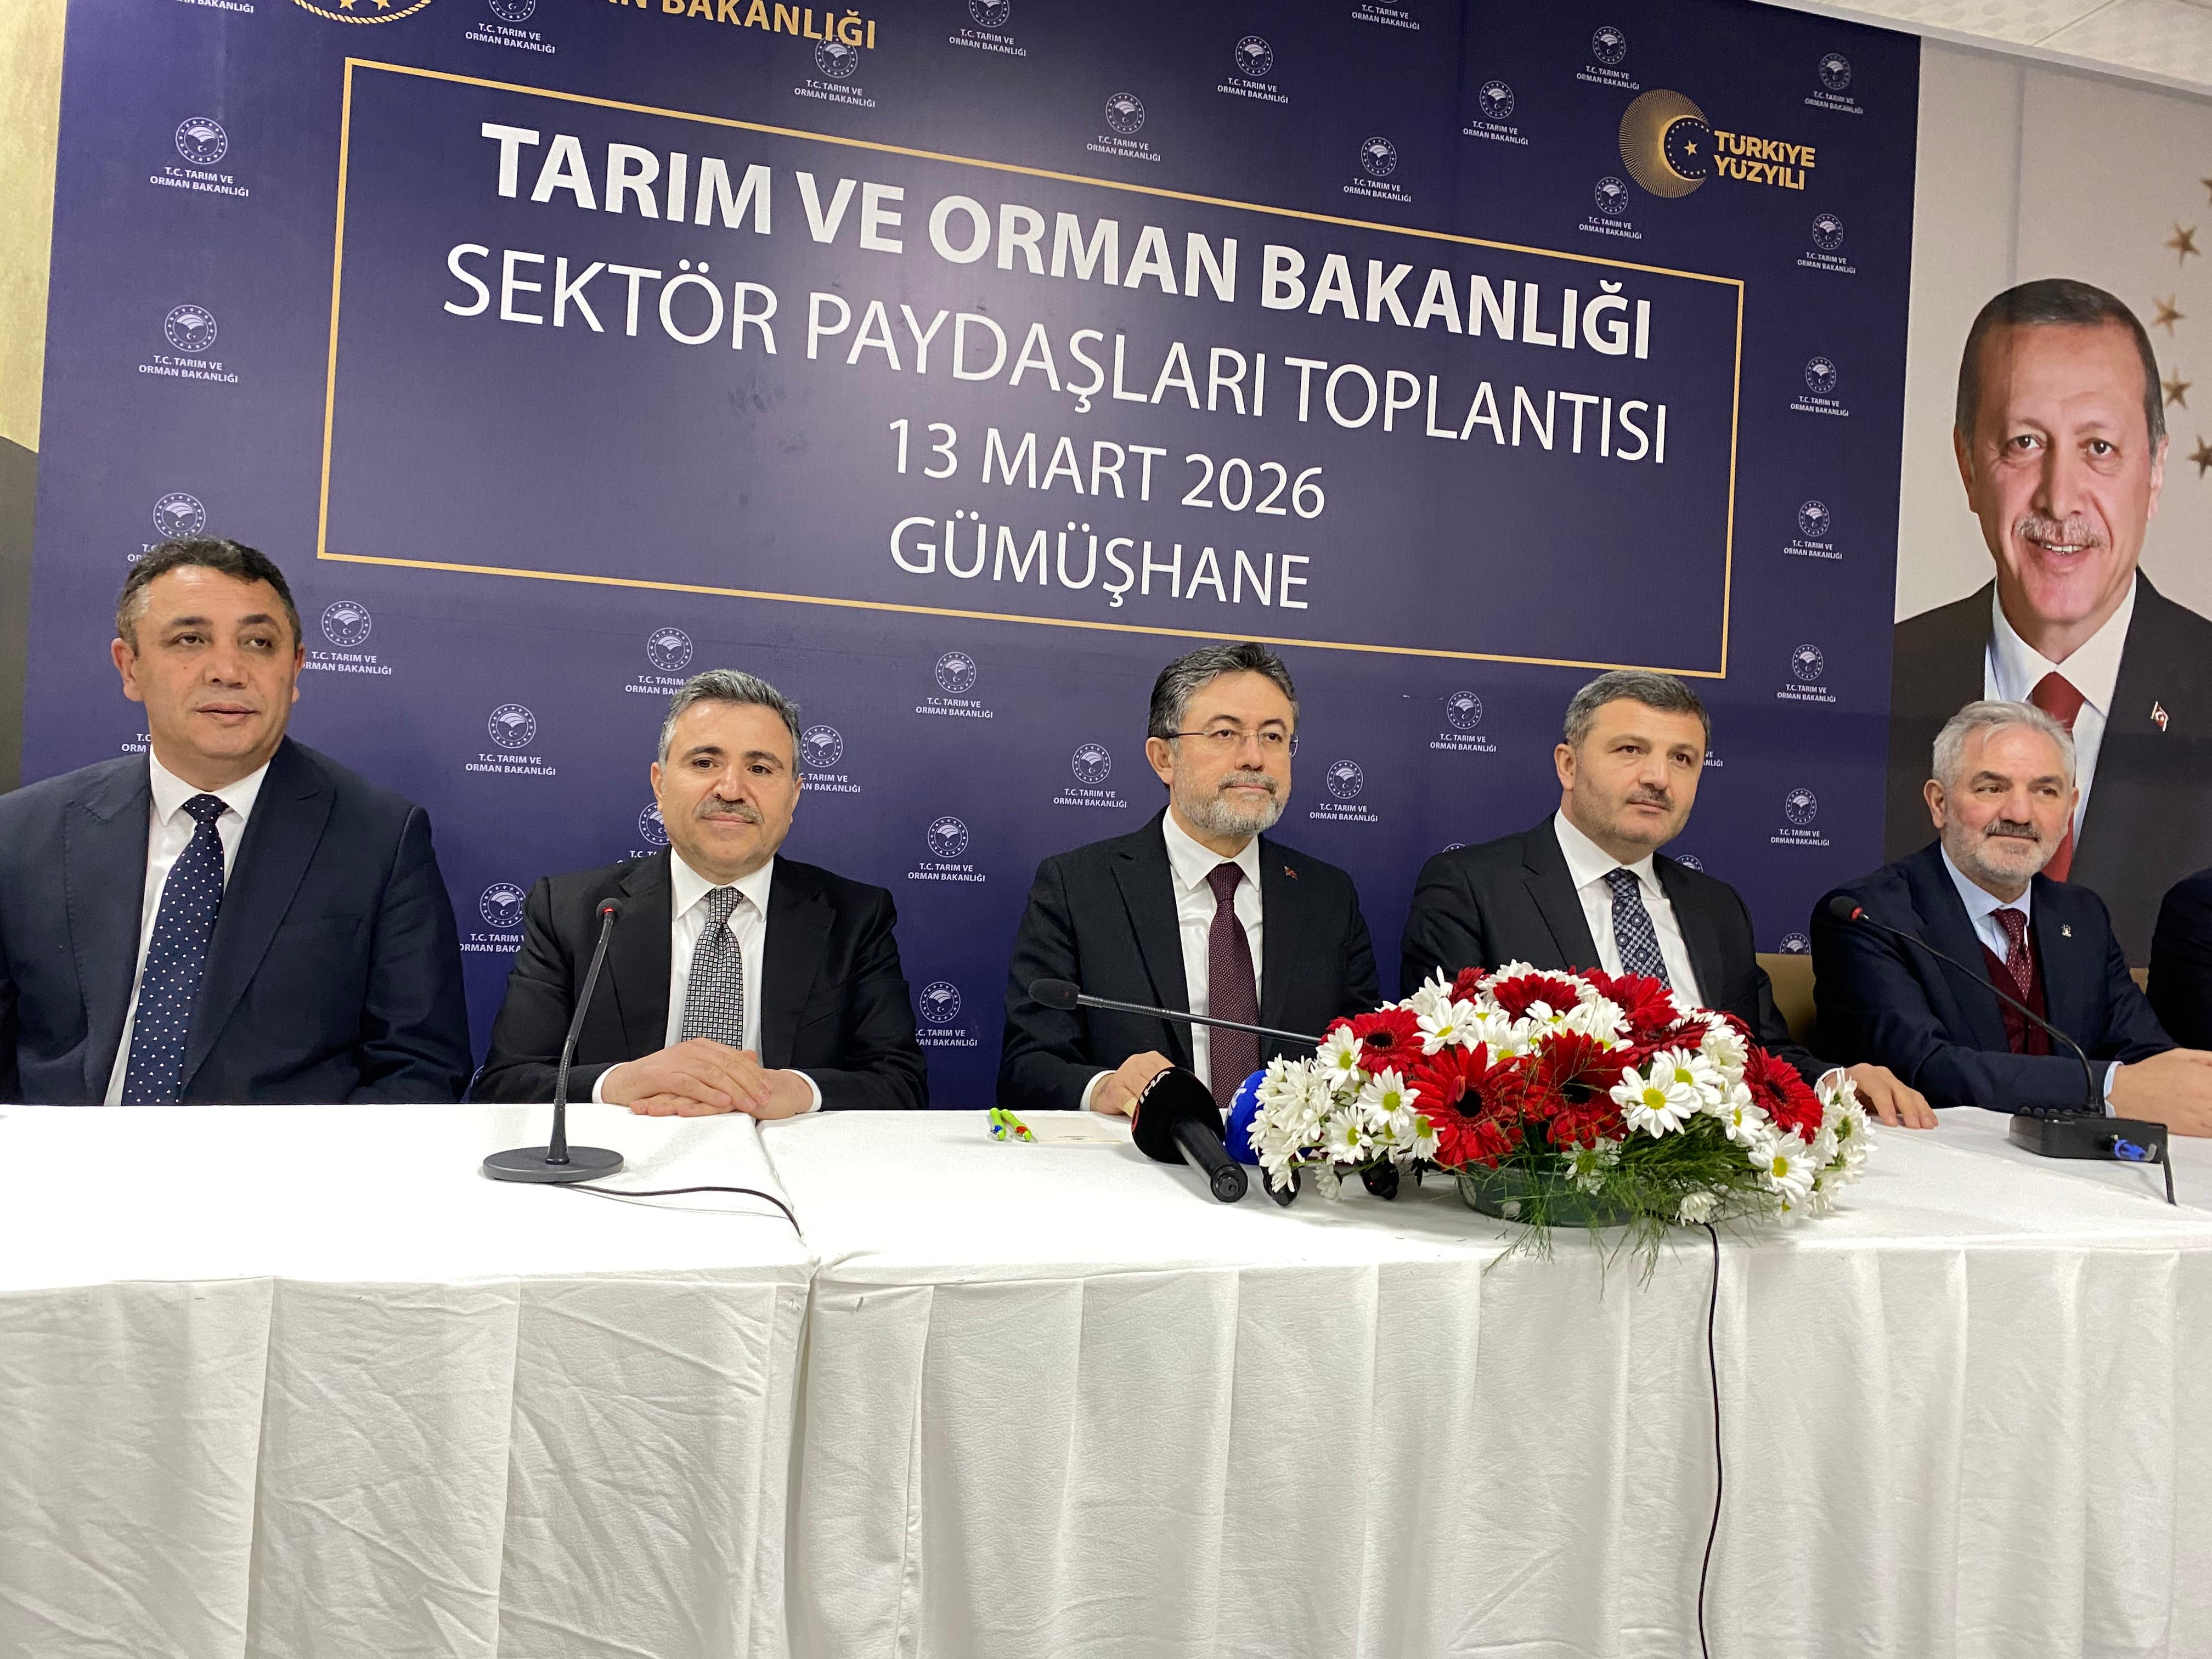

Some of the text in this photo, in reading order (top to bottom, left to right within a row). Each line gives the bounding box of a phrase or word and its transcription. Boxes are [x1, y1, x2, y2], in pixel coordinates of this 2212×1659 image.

[1361, 4, 1409, 20] T.C. TARIM VE
[1351, 12, 1420, 30] ORMAN BAKANLIĞI
[478, 22, 541, 41] T.C. TARIM VE
[961, 29, 1014, 45] T.C. TARIM VE
[465, 31, 555, 54] ORMAN BAKANLIĞI
[949, 36, 1026, 57] ORMAN BAKANLIĞI
[1576, 72, 1602, 83] ORMAN
[1598, 67, 1620, 78] TARIM
[1621, 72, 1629, 80] VE
[806, 79, 863, 96] T.C. TARIM VE
[1228, 77, 1277, 93] T.C. TARIM VE
[794, 87, 876, 108] ORMAN BAKANLIĞI
[1217, 84, 1288, 104] ORMAN BAKANLIĞI
[1472, 121, 1518, 135] T.C. TARIM VE
[1098, 135, 1149, 151] T.C. TARIM VE
[1463, 128, 1528, 145] ORMAN BAKANLIĞI
[1086, 143, 1161, 162] ORMAN BAKANLIĞI
[165, 166, 233, 184] T.C. TARIM VE
[150, 176, 249, 197] ORMAN BAKANLIĞI
[1353, 178, 1401, 192] T.C. TARIM VE
[1343, 185, 1412, 202] ORMAN BAKANLIĞI
[1589, 216, 1632, 230] T.C. TARIM VE
[1579, 223, 1642, 240] ORMAN BAKANLIĞI
[482, 122, 1650, 359] TARIM VE ORMAN BAKANLIĞI
[444, 244, 1666, 463] SEKTÖR PAYDAŞLARI TOPLANTISI
[153, 355, 222, 371] T.C. TARIM VE
[138, 364, 238, 383] ORMAN BAKANLIĞI
[1790, 403, 1814, 413] ORMAN
[1810, 397, 1831, 406] TARIM
[889, 419, 1324, 518] 13 MART 2026
[1784, 547, 1808, 556] ORMAN
[1804, 541, 1824, 549] TARIM
[890, 510, 1309, 608] GÜMÜŞHANE
[312, 651, 377, 663] T.C. TARIM VE
[302, 661, 392, 675] RMAN BAKANLIĞI
[637, 675, 684, 686] T.C. TARIM
[625, 685, 660, 694] ORMAN
[1797, 685, 1818, 693] TARIM
[927, 697, 981, 708] T.C. TARIM VE
[1777, 692, 1836, 703] ORMAN BAKANLIĞI
[916, 706, 993, 719] ORMAN BAKANLIĞI
[1453, 734, 1475, 742] TARIM
[121, 743, 147, 753] ORM
[1430, 742, 1497, 752] ORMAN BAKANLIĞI
[478, 753, 541, 765] T.C. TARIM VE
[465, 763, 556, 776] ORMAN BAKANLIĞI
[808, 773, 835, 782] TARIM
[814, 783, 861, 793] BAKANLIĞI
[1079, 789, 1103, 798] TARIM
[1053, 797, 1127, 808] ORMAN BAKANLIĞI
[1333, 804, 1356, 812] TARIM
[1310, 811, 1378, 822] ORMAN BAKANLIĞI
[1796, 838, 1830, 846] BAKANLIĞI
[919, 862, 973, 872] T.C. TARIM VE
[908, 872, 985, 882] ORMAN BAKANLIĞI
[470, 933, 487, 941] T.C.
[488, 934, 518, 943] TARIM
[933, 1038, 978, 1046] BAKANLIĞI
